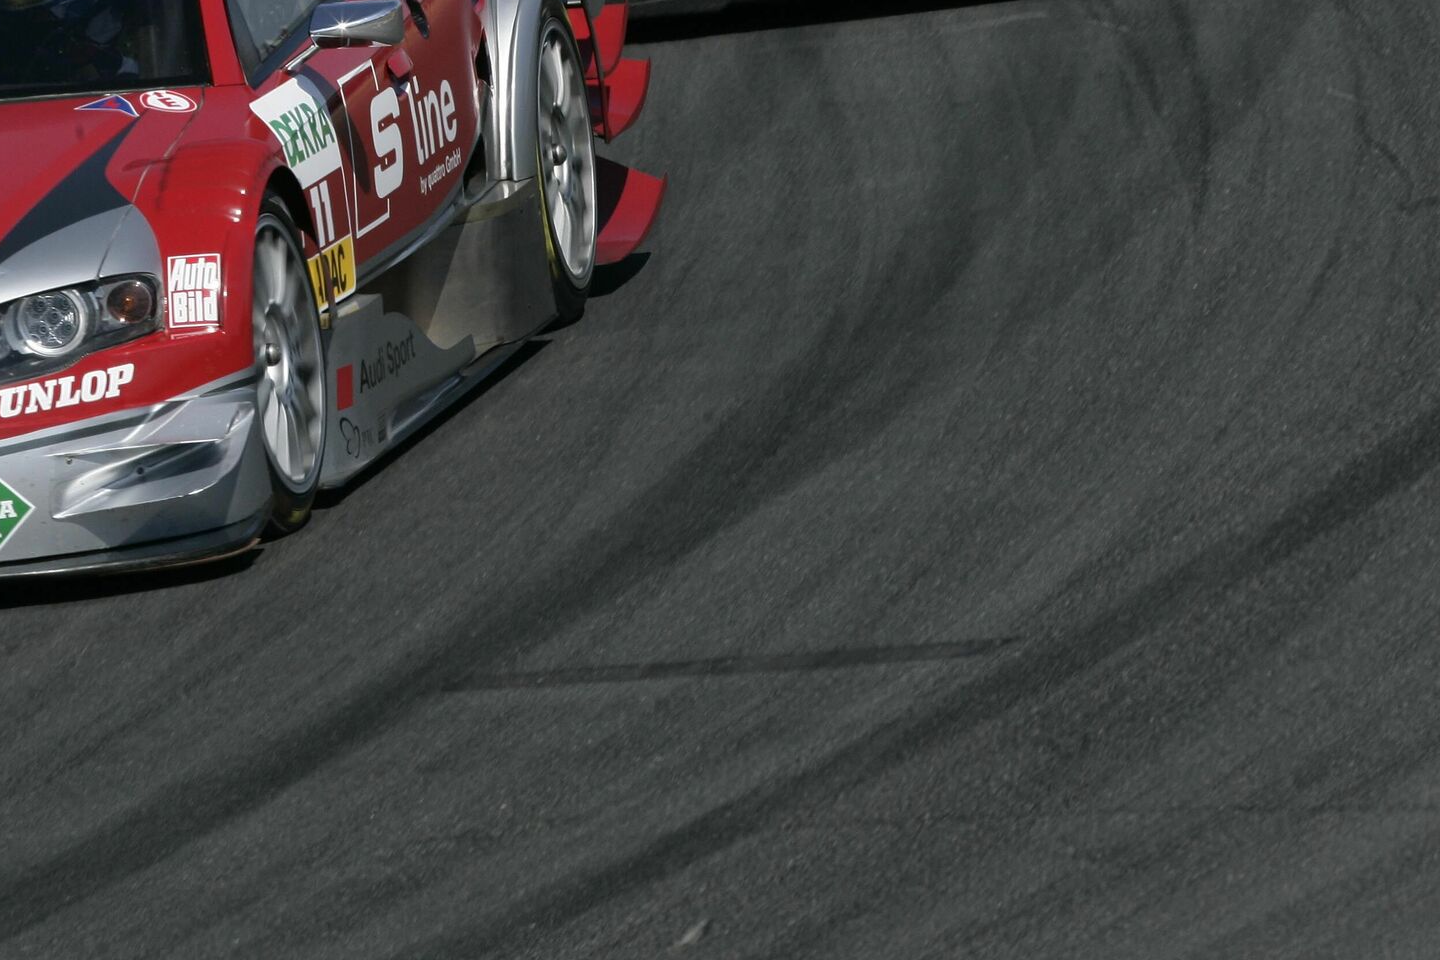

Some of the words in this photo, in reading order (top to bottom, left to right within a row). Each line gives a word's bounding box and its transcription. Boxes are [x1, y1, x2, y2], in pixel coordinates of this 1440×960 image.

[268, 102, 335, 168] DEKRA
[370, 86, 404, 199] S
[408, 76, 458, 165] line
[310, 180, 335, 248] 11
[170, 257, 219, 291] Auto
[172, 290, 218, 323] Bild
[360, 352, 386, 393] Audi
[386, 329, 416, 377] Sport
